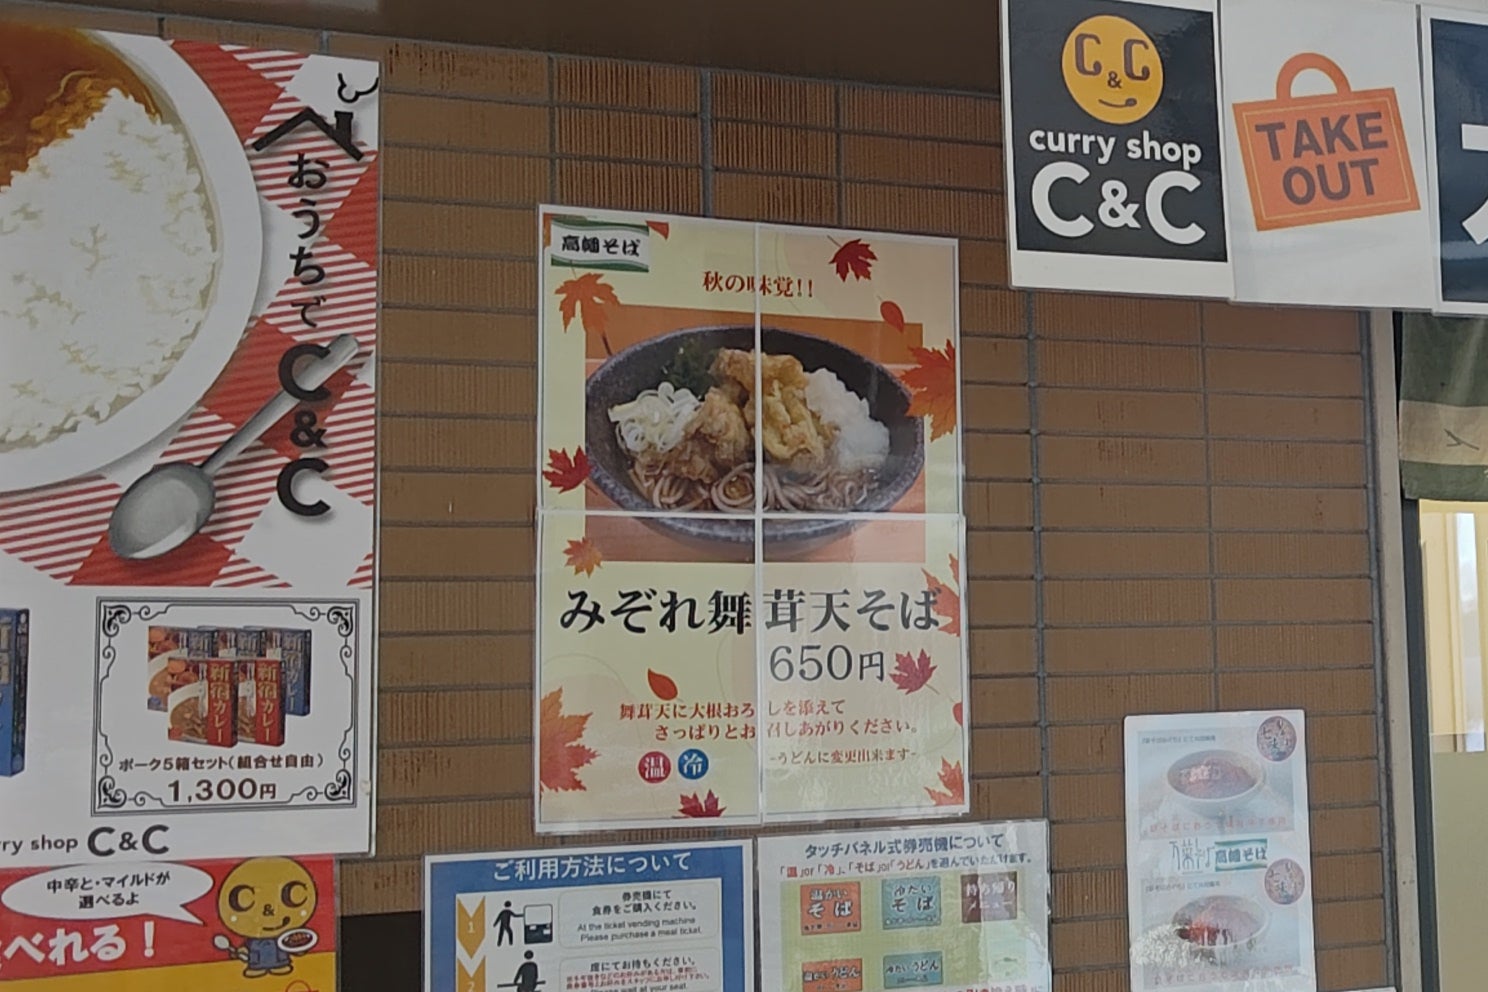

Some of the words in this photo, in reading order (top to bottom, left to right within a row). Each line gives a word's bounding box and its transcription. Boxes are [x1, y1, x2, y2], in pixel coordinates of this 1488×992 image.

[1029, 129, 1116, 164] curry
[1126, 133, 1201, 171] shop
[1255, 111, 1388, 162] TAKE
[1282, 159, 1380, 206] OUT
[1031, 162, 1207, 245] C&C
[288, 153, 329, 328] おうちで
[561, 234, 641, 257] 高幡そば
[277, 344, 332, 517] C&C
[560, 588, 940, 635] みぞれ舞茸天そば
[769, 645, 885, 682] 650円
[119, 755, 324, 772] ポーク5箱セット(組合せ自由)
[168, 778, 276, 802] 1,300円
[31, 835, 78, 852] shop
[87, 824, 170, 857] C&C
[493, 852, 692, 880] ご利用方法について
[79, 892, 140, 909] 選べるよ
[580, 933, 609, 942] Please
[590, 922, 602, 931] the
[628, 918, 660, 930] vending
[661, 916, 696, 926] machine
[0, 921, 156, 966] べれる！
